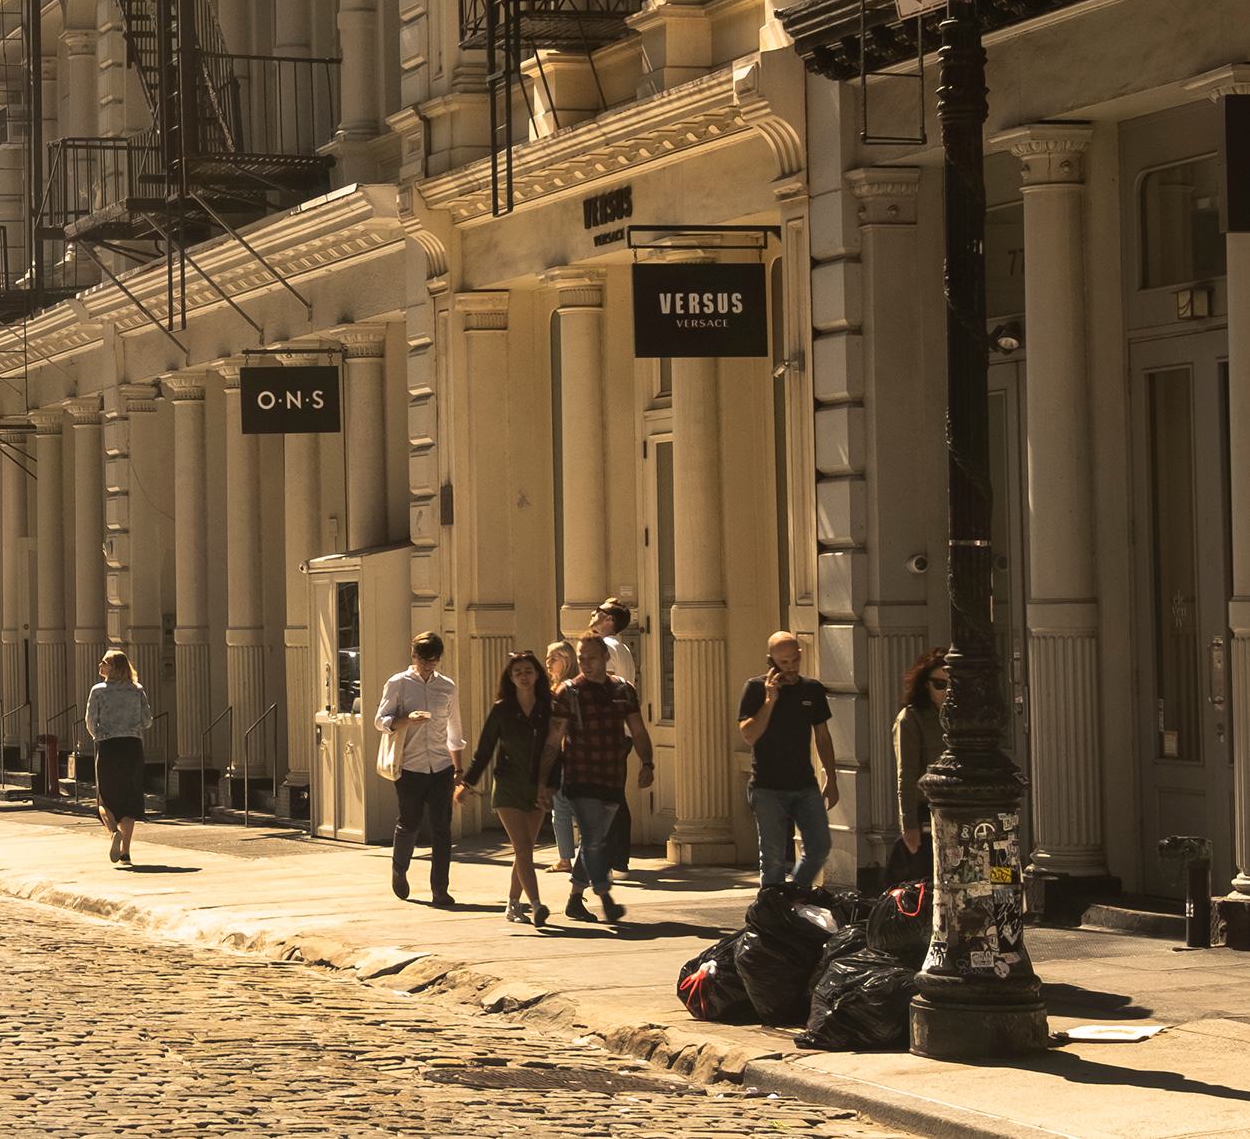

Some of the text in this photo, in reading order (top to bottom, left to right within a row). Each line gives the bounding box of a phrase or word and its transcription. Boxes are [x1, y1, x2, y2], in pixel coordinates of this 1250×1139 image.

[583, 186, 633, 229] VERSUS
[659, 292, 744, 314] VERSUS
[676, 318, 729, 328] VERSACE
